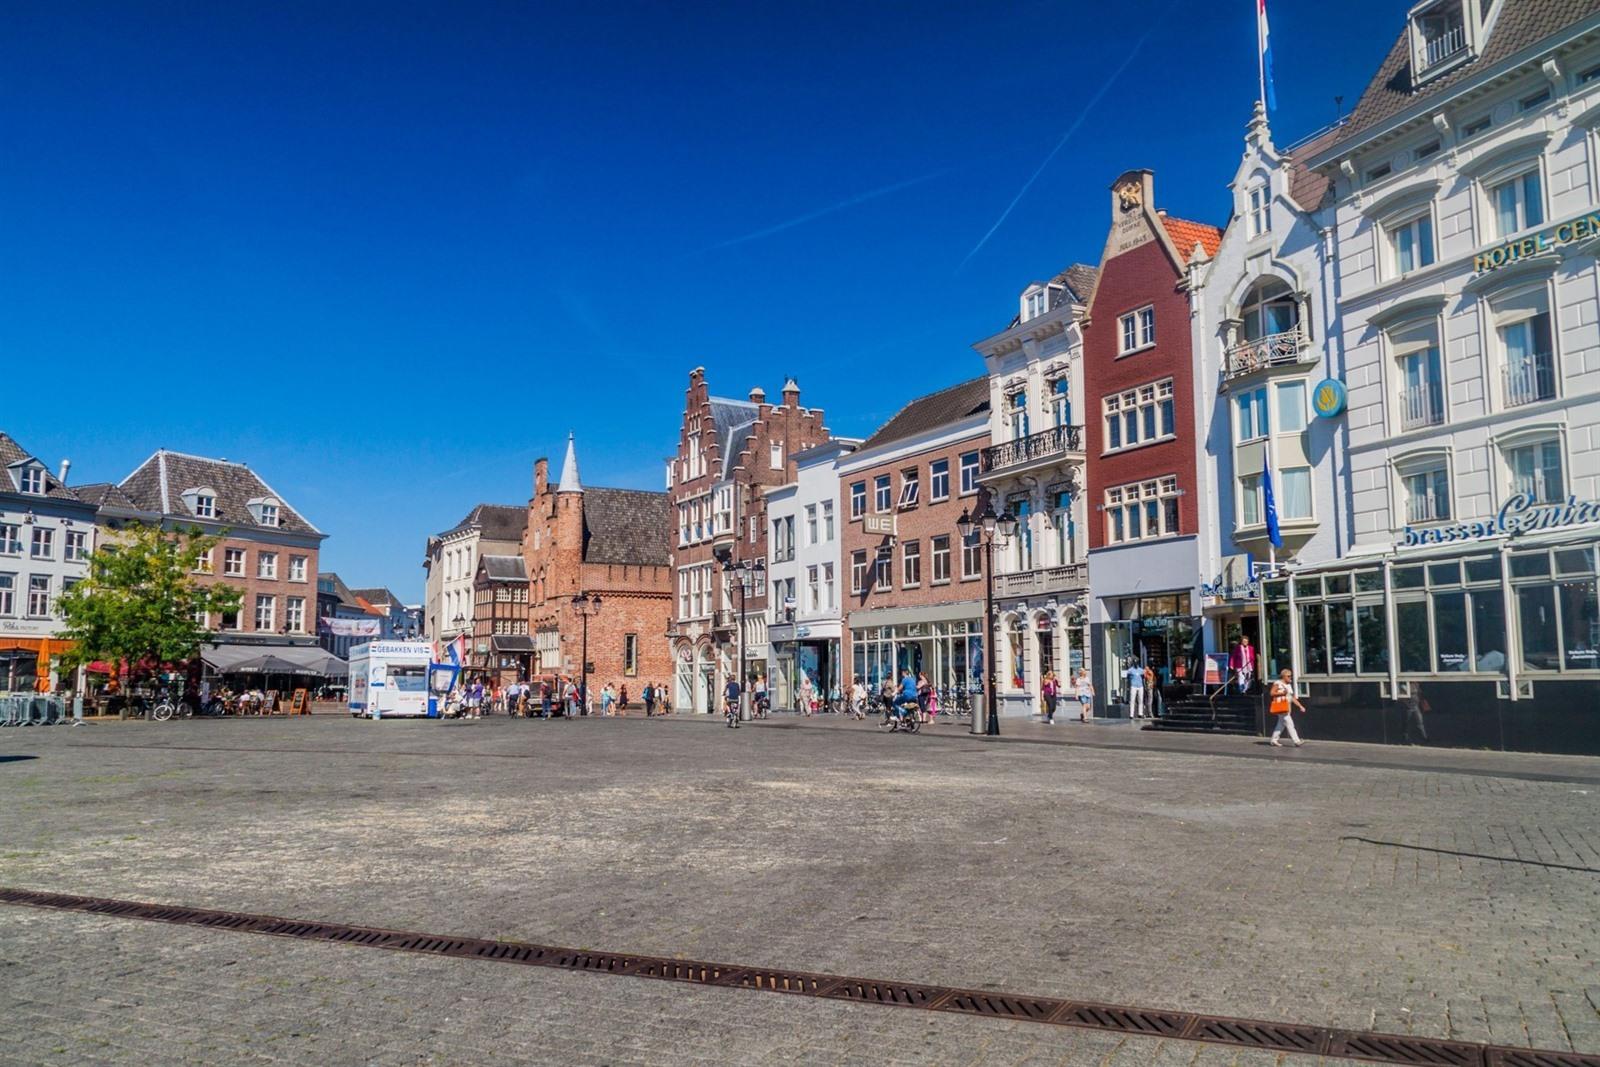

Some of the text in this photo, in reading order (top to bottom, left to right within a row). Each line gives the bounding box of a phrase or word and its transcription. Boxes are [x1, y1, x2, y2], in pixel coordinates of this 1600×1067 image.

[1473, 233, 1550, 273] HOTEL
[868, 517, 891, 531] WE
[1402, 515, 1519, 547] brassere
[952, 622, 966, 633] WE
